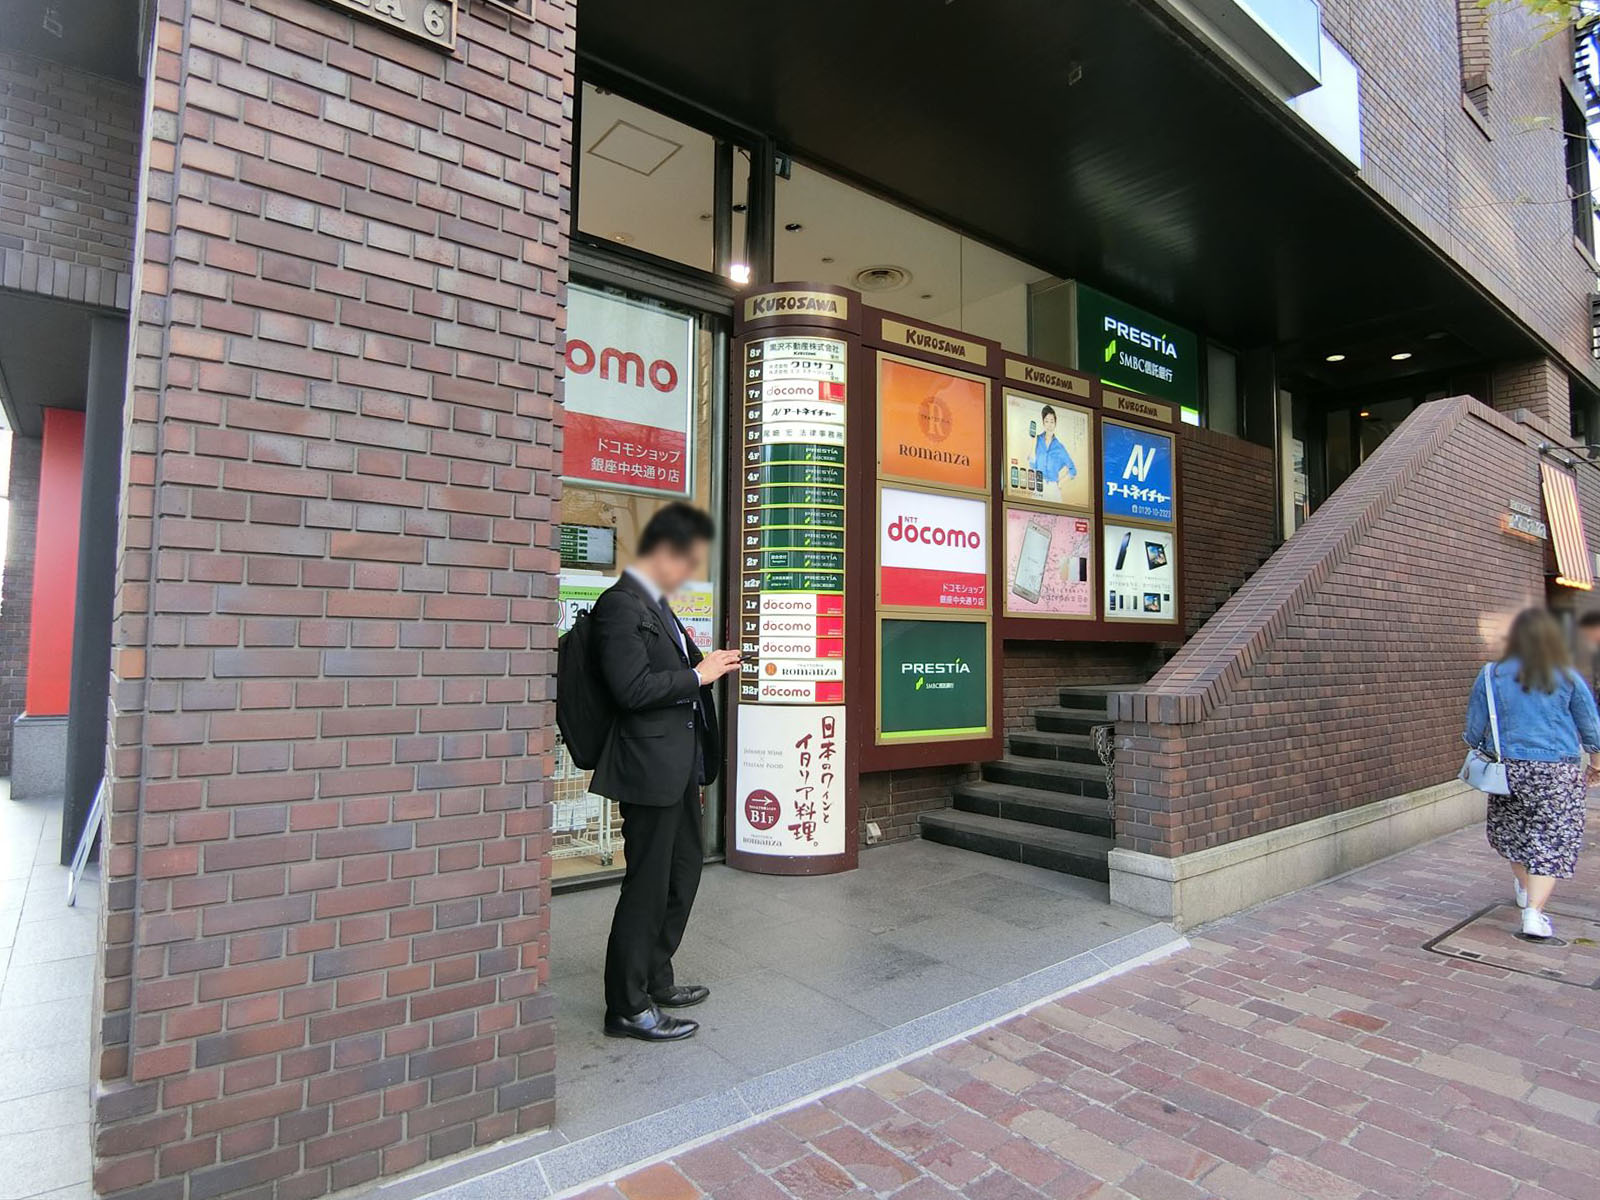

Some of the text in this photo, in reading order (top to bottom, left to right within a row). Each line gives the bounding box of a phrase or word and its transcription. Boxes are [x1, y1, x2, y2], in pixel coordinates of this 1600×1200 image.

[423, 3, 446, 37] 6
[753, 296, 838, 316] KUROSAWA
[905, 329, 966, 358] KUROSAWA
[1024, 367, 1073, 391] KUROSAWA
[767, 384, 814, 396] docomo
[1118, 397, 1158, 417] KUROSAWA
[598, 438, 681, 463] ドコモショップ
[591, 456, 680, 483] 銀座中央通り店
[1107, 481, 1171, 503] アートネイチャー
[887, 515, 981, 550] docomo
[942, 583, 985, 595] ドコモショップ
[763, 599, 812, 610] docomo
[763, 620, 812, 631] docomo
[762, 642, 811, 653] docomo
[761, 685, 811, 697] docomo
[818, 715, 836, 824] 日本のワインと
[750, 811, 774, 824] B1F
